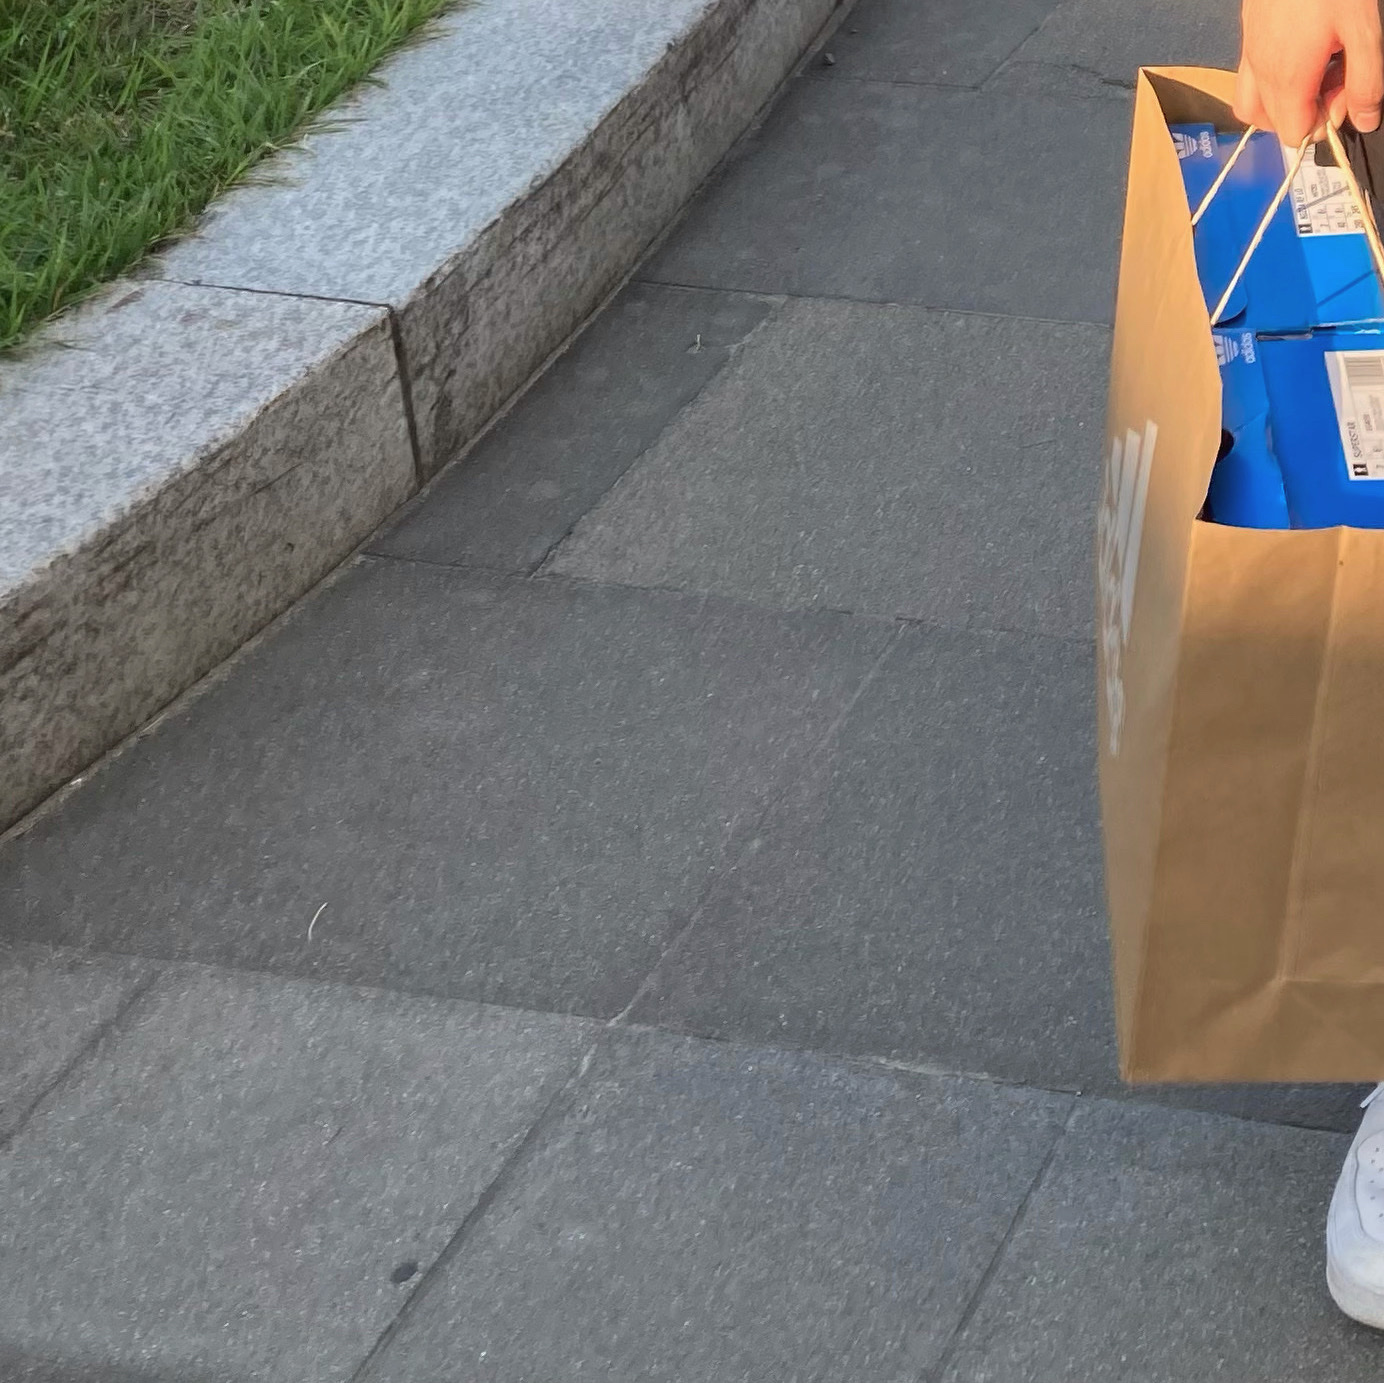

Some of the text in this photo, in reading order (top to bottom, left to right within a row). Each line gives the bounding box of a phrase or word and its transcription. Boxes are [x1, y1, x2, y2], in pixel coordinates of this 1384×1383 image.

[1198, 130, 1213, 159] adidas
[1240, 332, 1256, 364] adidas
[1347, 421, 1363, 458] SUPERSTAR
